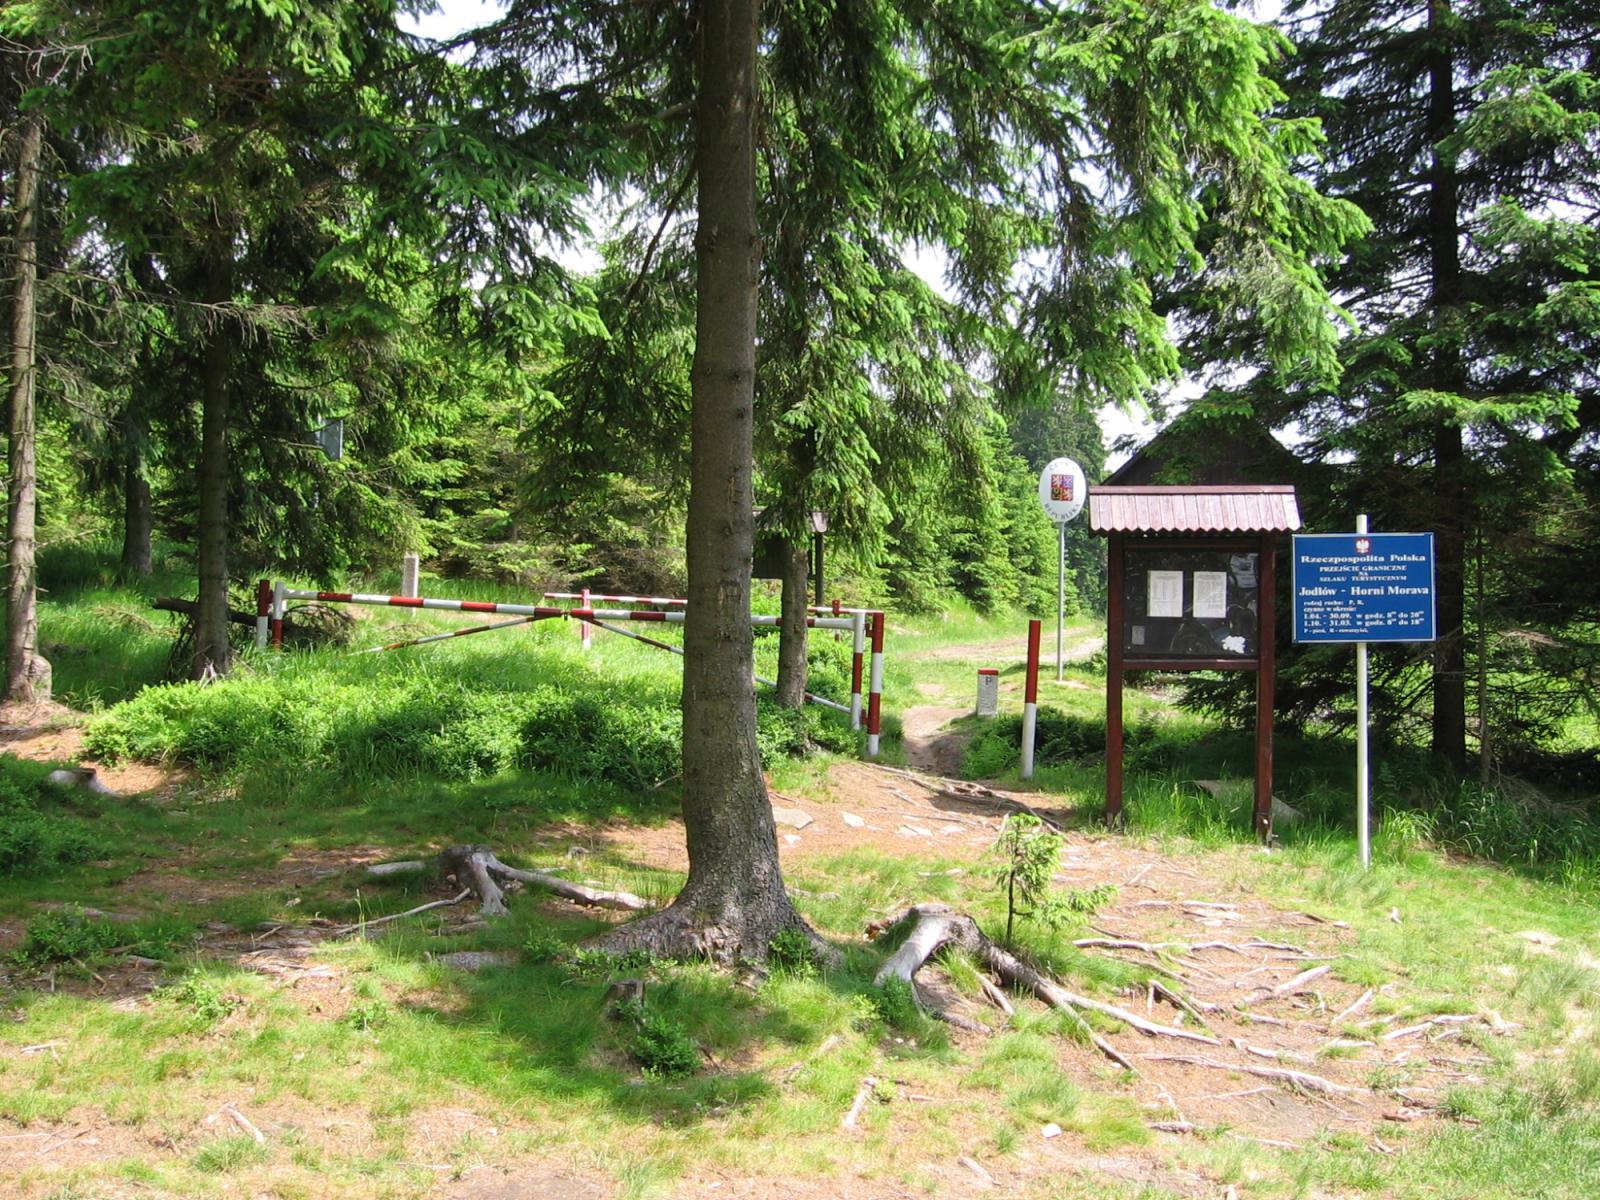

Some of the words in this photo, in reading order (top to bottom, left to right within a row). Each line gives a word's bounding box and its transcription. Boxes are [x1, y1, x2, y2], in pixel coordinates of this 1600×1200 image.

[1301, 555, 1385, 564] Rzeczpospolita
[1390, 554, 1426, 562] Polska
[1387, 586, 1429, 595] Morava
